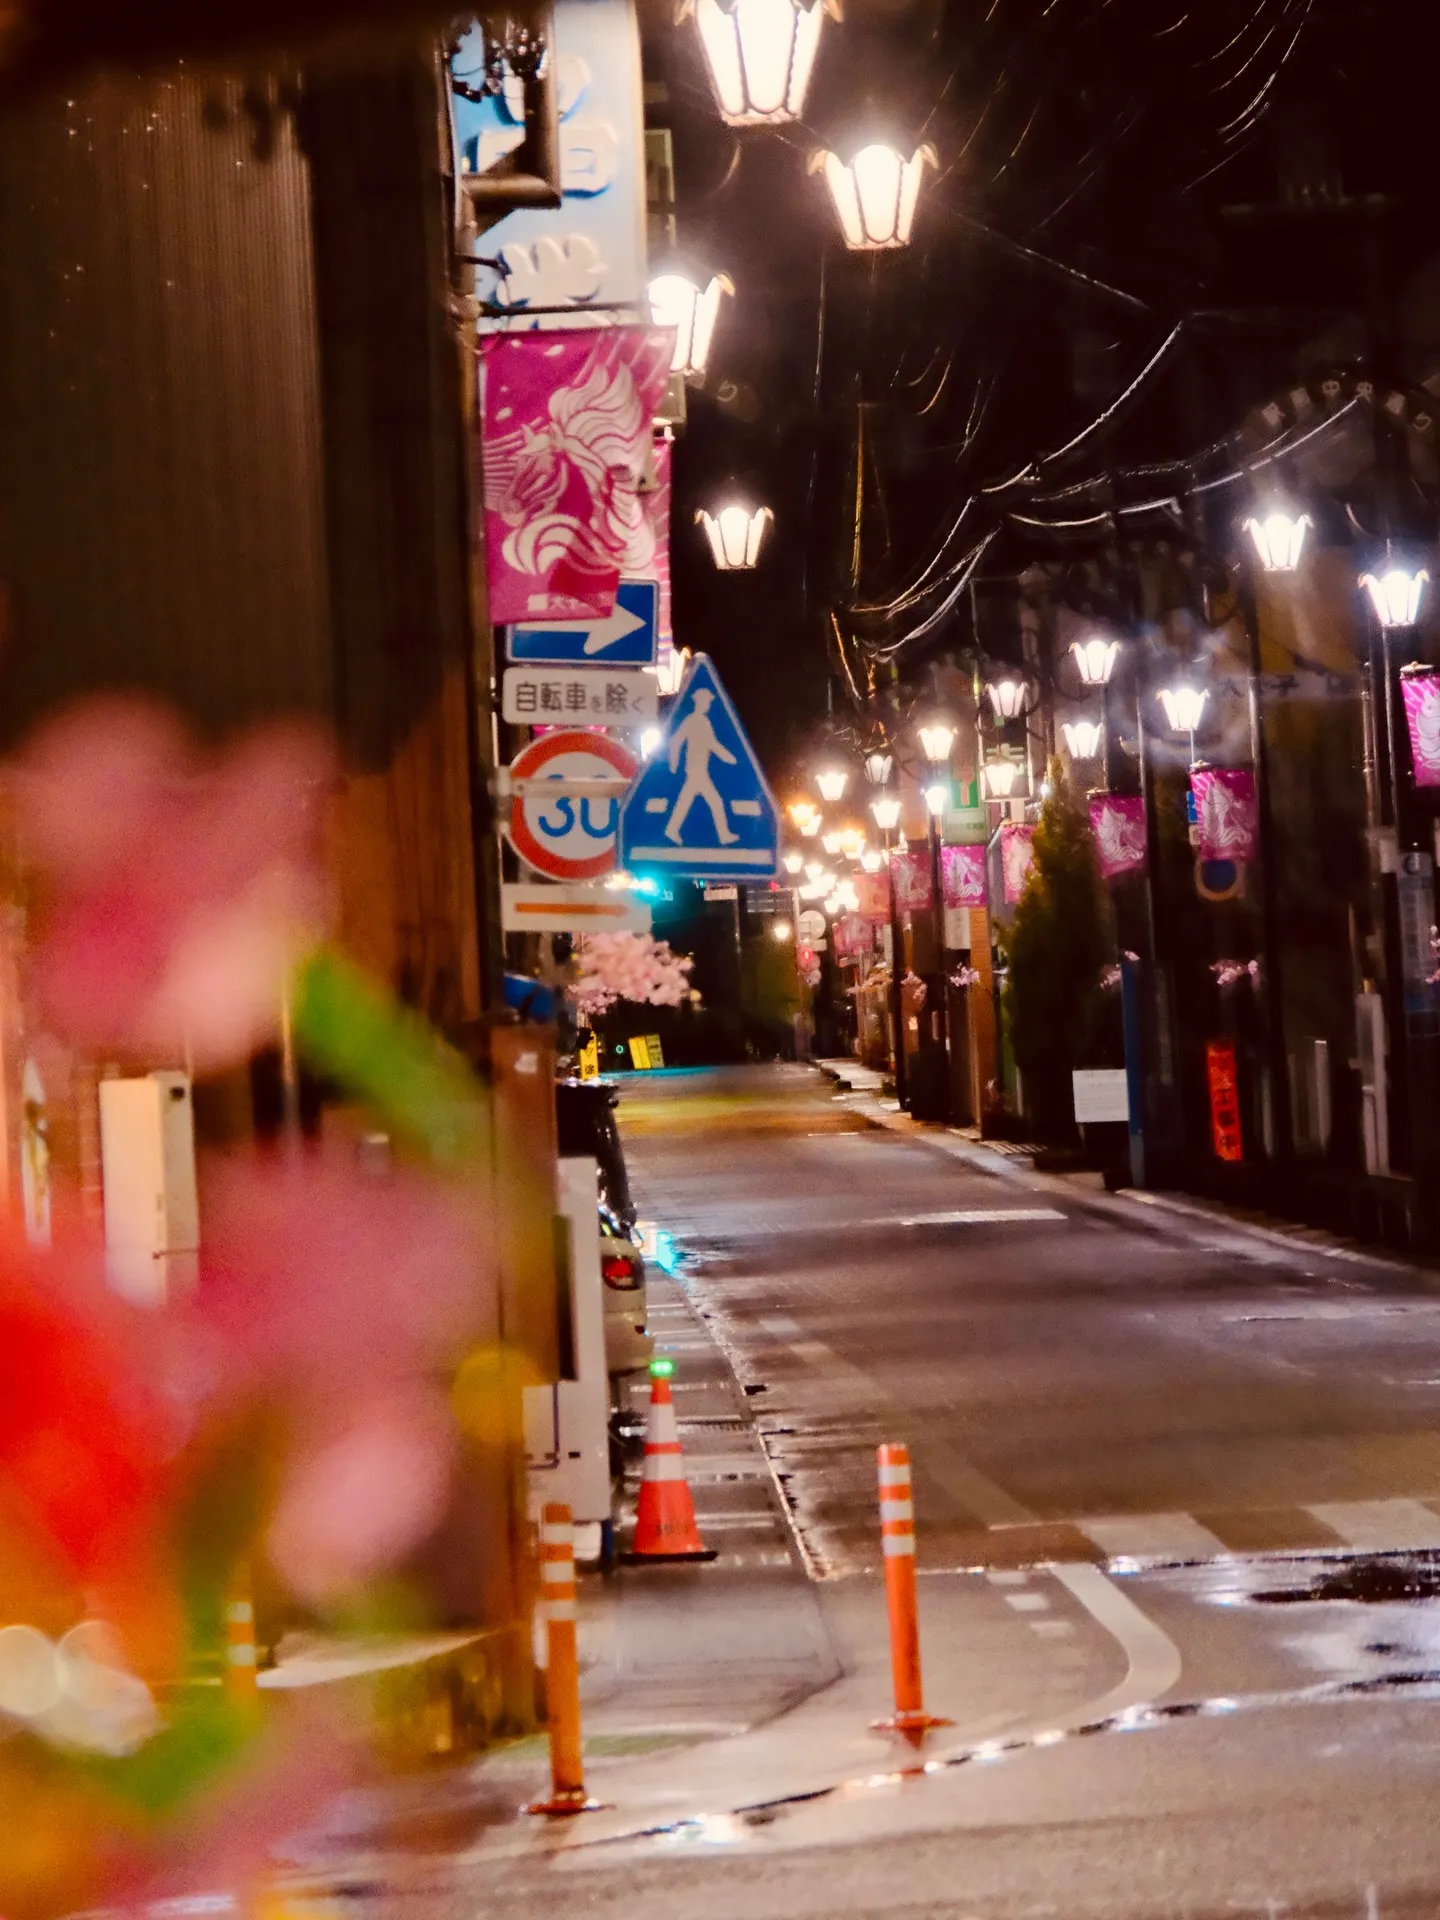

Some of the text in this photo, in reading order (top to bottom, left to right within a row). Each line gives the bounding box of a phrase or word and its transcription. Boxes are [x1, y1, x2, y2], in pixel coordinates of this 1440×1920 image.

[516, 681, 645, 713] 自転車を除く
[538, 774, 618, 838] 30
